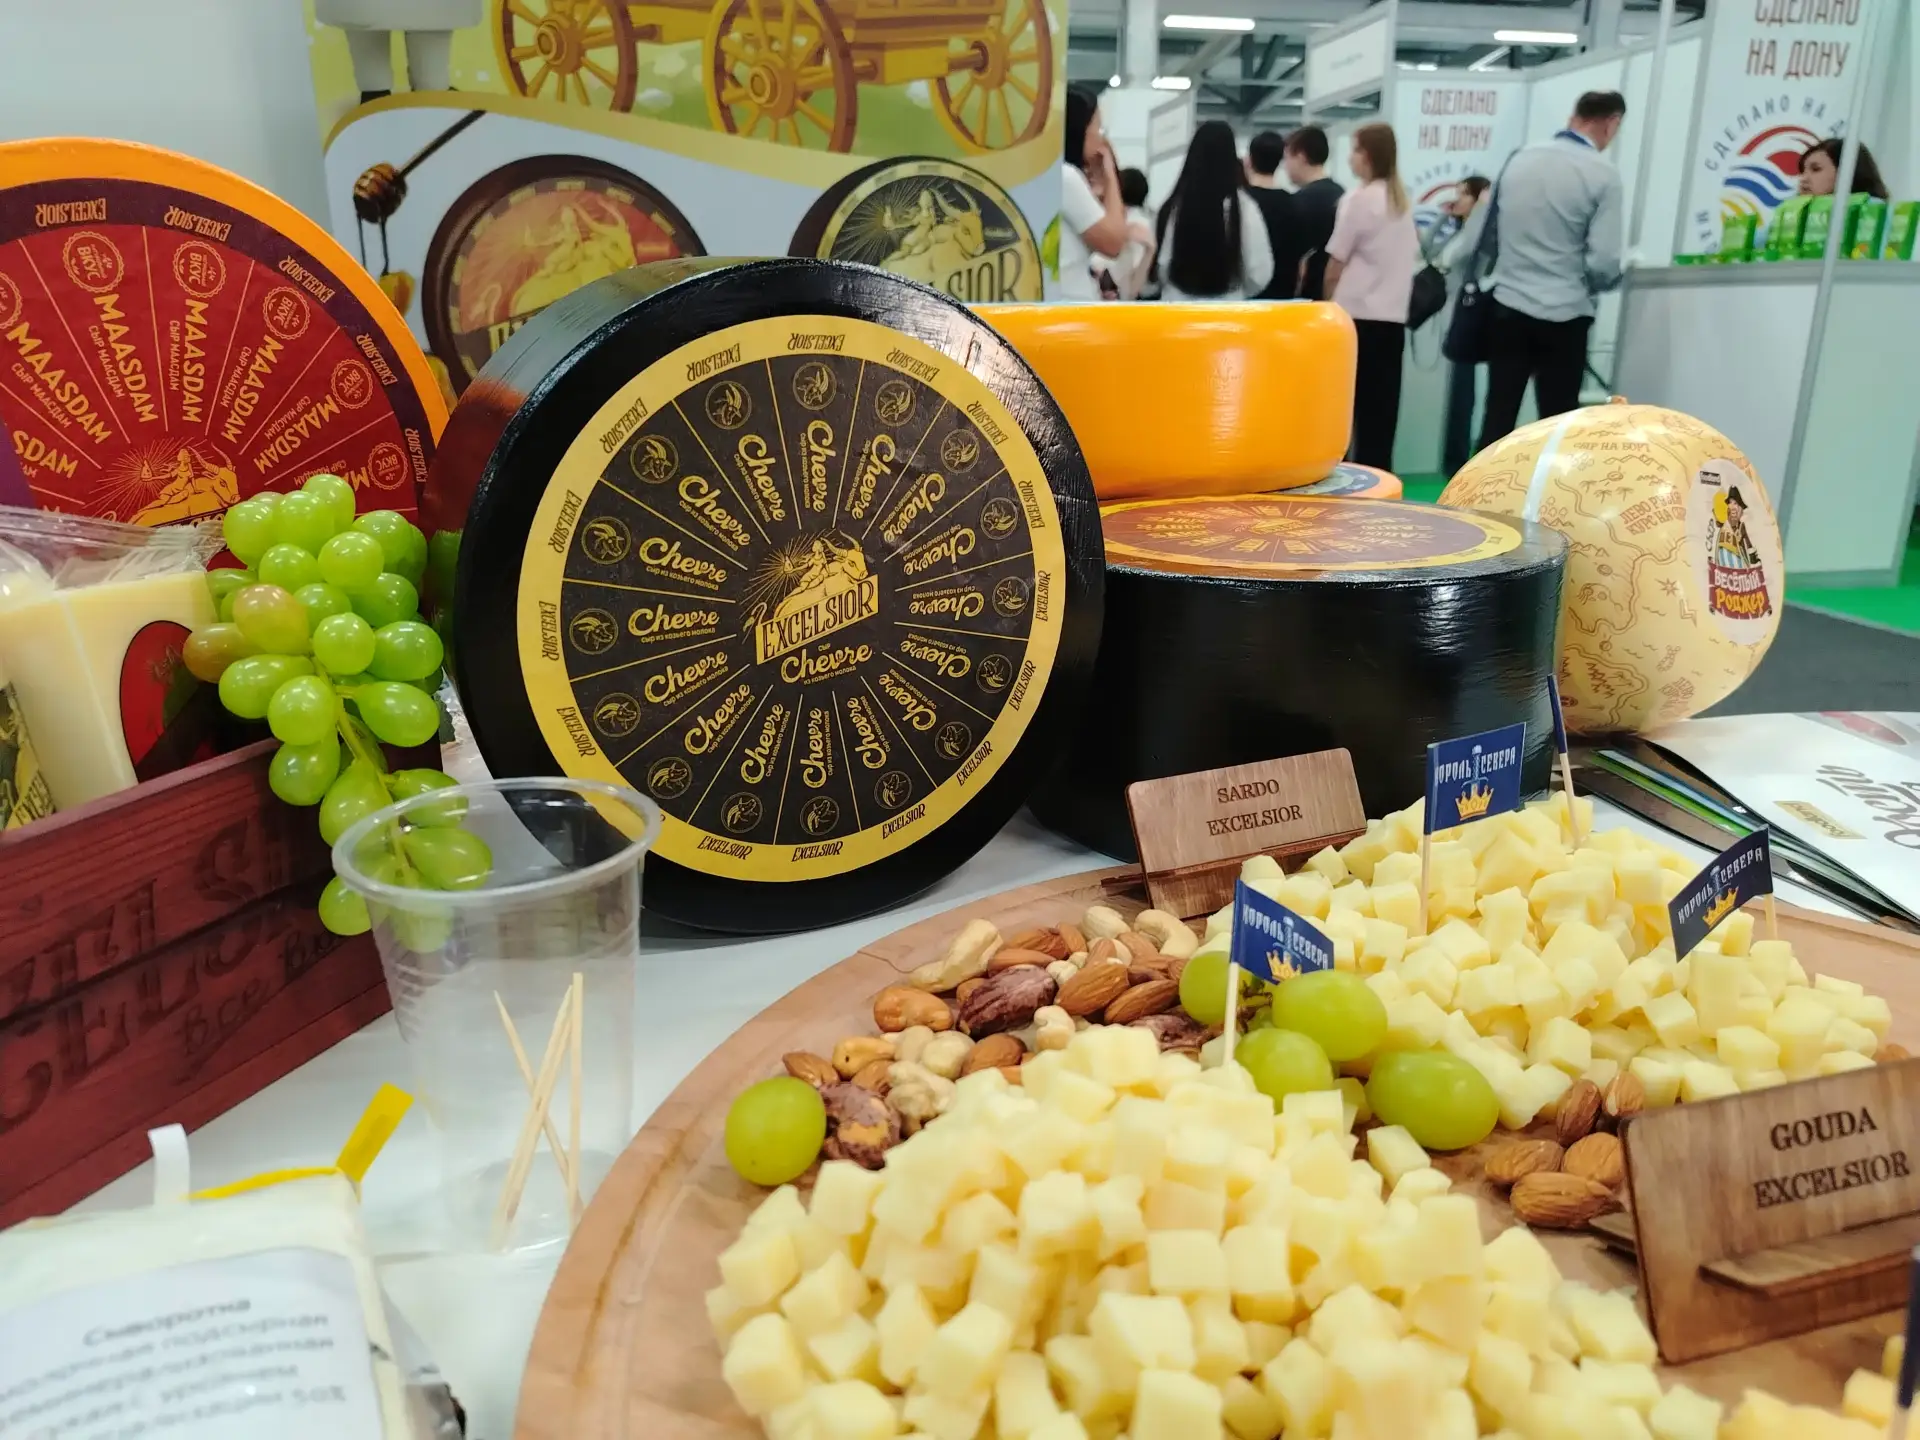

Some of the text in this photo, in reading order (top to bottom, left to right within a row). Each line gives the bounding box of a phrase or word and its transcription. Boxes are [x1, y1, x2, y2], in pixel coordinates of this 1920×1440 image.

[1755, 0, 1860, 27] СДЕЛАНО
[1745, 39, 1850, 80] НА ДОНУ
[1420, 89, 1497, 116] СДЕЛАНО
[1418, 125, 1492, 152] НА ДОНУ
[35, 198, 106, 227] EXCELSIOR
[163, 205, 232, 242] EXCELSIOR
[189, 252, 202, 285] ВКУС
[278, 254, 336, 304] EXCELSIOR
[94, 294, 158, 423] MAASDAM
[182, 298, 209, 423] MAASDAM
[356, 332, 398, 387] EXCELSIOR
[686, 342, 741, 382] EXCELSIOR
[787, 333, 845, 351] EXCELSIOR
[886, 347, 940, 382] EXCELSIOR
[5, 321, 112, 444] MAASDAM
[221, 334, 284, 444] MAASDAM
[253, 393, 341, 475] MAASDAM
[599, 397, 648, 454] EXCELSIOR
[966, 400, 1008, 446] EXCELSIOR
[1600, 442, 1618, 450] НА
[13, 430, 79, 479] SDAM
[738, 434, 786, 521] Chevre
[807, 420, 836, 512] Chevre
[852, 434, 895, 520] Chevre
[548, 489, 583, 554] EXCELSIOR
[679, 475, 751, 546] Chevre
[883, 473, 946, 543] Chevre
[1018, 480, 1045, 529] EXCELSIOR
[1620, 501, 1652, 525] ЛЕВО
[1625, 515, 1658, 535] КУРС
[1654, 509, 1674, 524] НА
[639, 537, 728, 582] Chevre
[904, 528, 975, 575] Chevre
[1035, 569, 1052, 622] EXCELSIOR
[1714, 569, 1762, 593] ВЕСЁЛЫЙ
[538, 600, 559, 661] EXCELSIOR
[628, 604, 720, 636] Chevre
[762, 580, 875, 660] EXCELSIOR
[909, 592, 984, 621] Chevre
[644, 651, 728, 703] Chevre
[780, 644, 873, 683] Chevre
[900, 640, 971, 678] Chevre
[879, 674, 937, 731] Chevre
[1008, 659, 1037, 712] EXCELSIOR
[556, 706, 597, 758] EXCELSIOR
[684, 684, 750, 755] Chevre
[741, 703, 784, 784] Chevre
[847, 697, 887, 769] Chevre
[800, 707, 827, 788] Chevre
[955, 740, 994, 787] EXCELSIOR
[1481, 746, 1516, 774] СЕВЕРА
[1217, 778, 1280, 804] SARDO
[882, 803, 926, 839] EXCELSIOR
[1207, 804, 1303, 837] EXCELSIOR
[696, 834, 753, 861] EXCELSIOR
[791, 840, 844, 863] EXCELSIOR
[1678, 847, 1763, 924] КОРОЛЬ СЕВЕРА
[1242, 903, 1329, 970] КОРОЛЬ СЕВЕРА
[1770, 1106, 1877, 1152] GOUDA
[1753, 1150, 1911, 1211] EXCELSIOR
